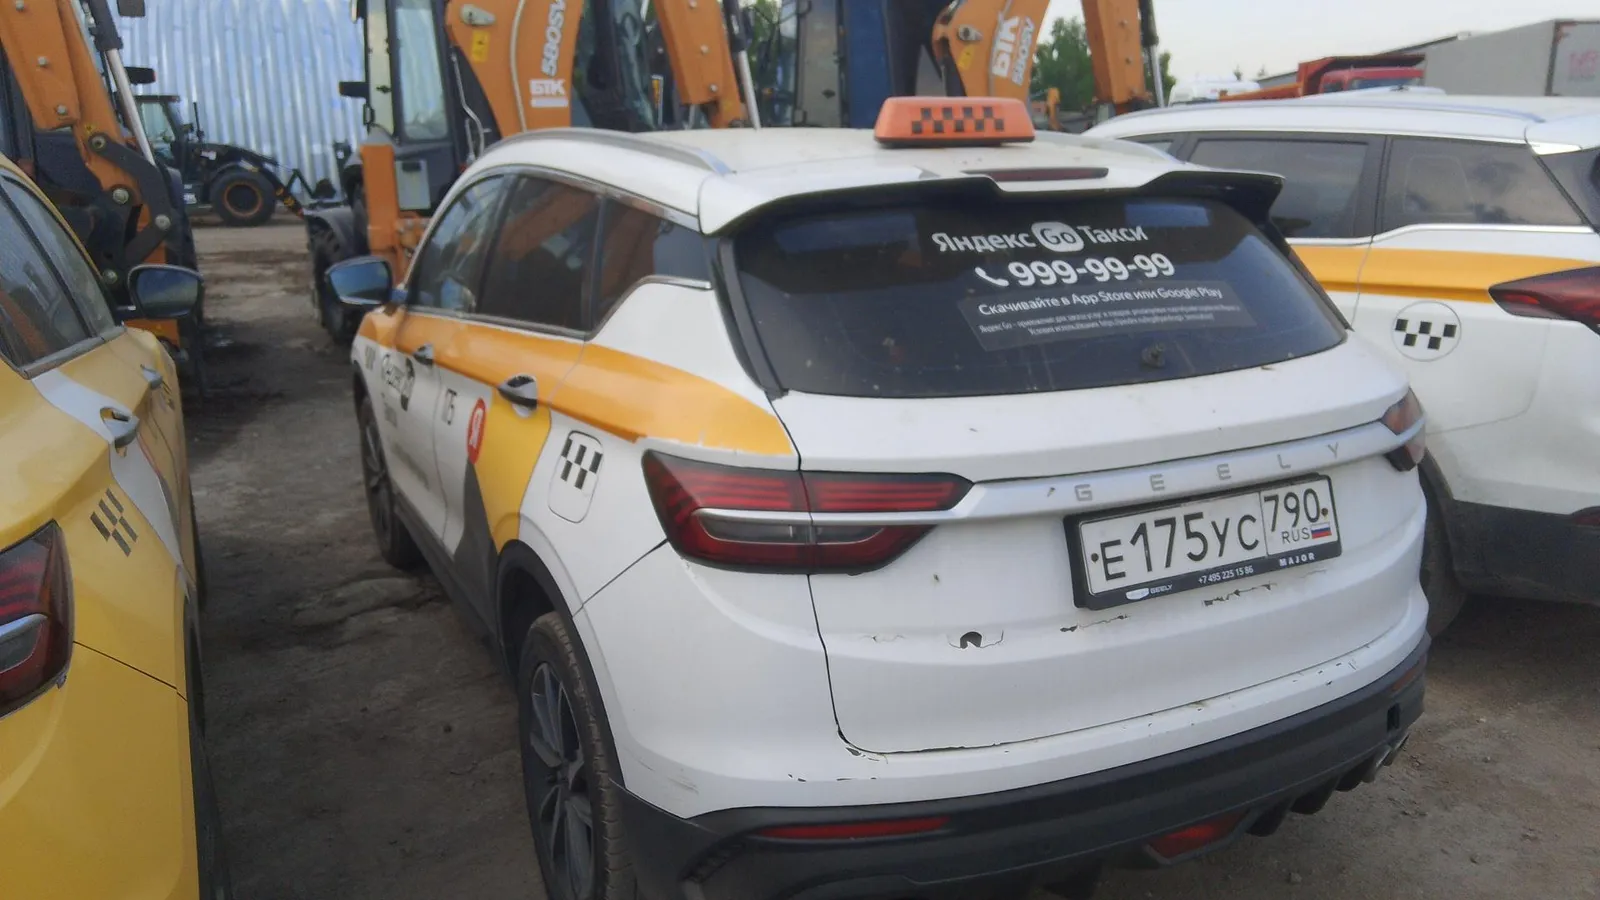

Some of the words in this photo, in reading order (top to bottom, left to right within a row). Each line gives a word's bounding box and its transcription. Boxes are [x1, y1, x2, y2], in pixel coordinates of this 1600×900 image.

[931, 231, 1036, 253] Яндекс
[1041, 226, 1078, 247] Go
[1078, 224, 1149, 244] Такси
[1008, 252, 1175, 286] 999-99-99
[978, 296, 1060, 316] Скачивайте
[1071, 291, 1099, 305] App
[1099, 289, 1133, 302] Store
[1134, 287, 1157, 299] или
[1157, 286, 1198, 300] Google
[1197, 286, 1222, 299] Play
[1074, 442, 1339, 501] GEELY
[1264, 488, 1320, 533] 790
[1282, 527, 1310, 544] RUS
[1150, 584, 1173, 595] GEELY
[1208, 572, 1221, 582] 495
[1222, 570, 1235, 580] 225
[1235, 567, 1244, 577] 15
[1280, 552, 1315, 567] MAJOR
